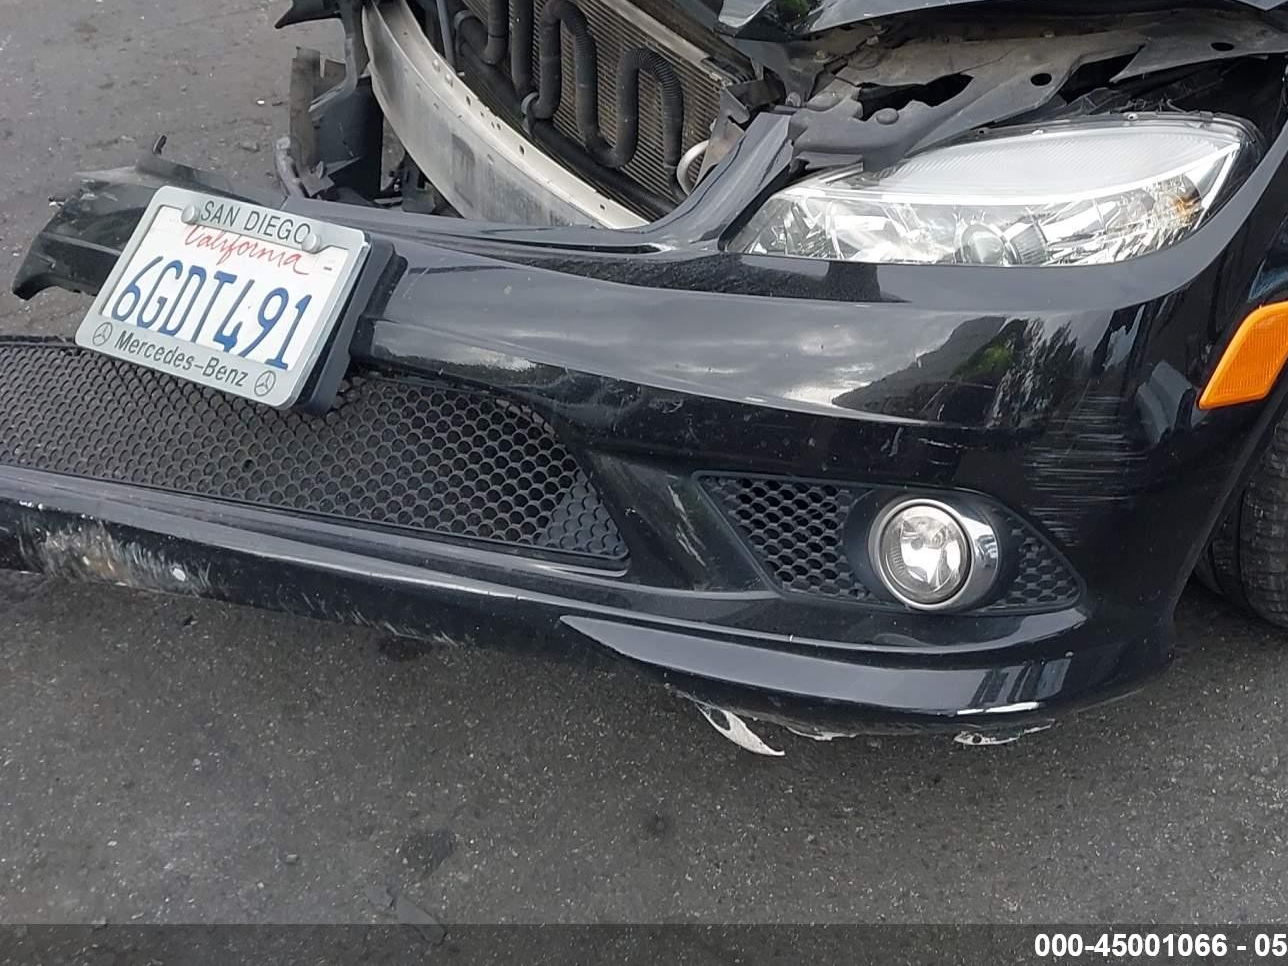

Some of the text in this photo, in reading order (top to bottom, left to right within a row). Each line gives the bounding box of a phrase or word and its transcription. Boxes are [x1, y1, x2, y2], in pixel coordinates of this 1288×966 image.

[200, 200, 312, 244] SAN DIEGO
[183, 224, 310, 276] California
[111, 255, 313, 370] 6GDT491
[114, 330, 249, 387] Mercedes-Benz
